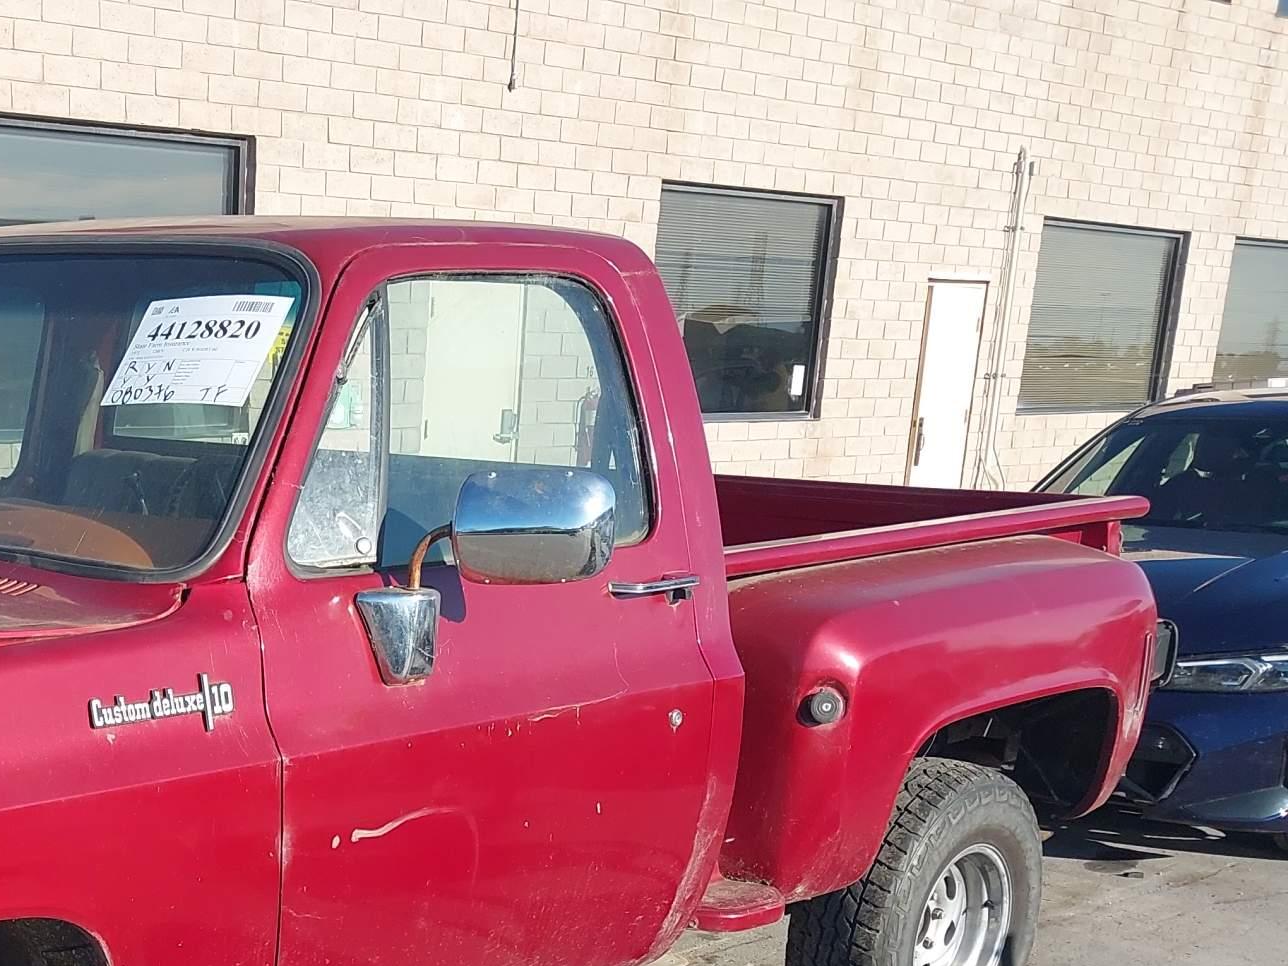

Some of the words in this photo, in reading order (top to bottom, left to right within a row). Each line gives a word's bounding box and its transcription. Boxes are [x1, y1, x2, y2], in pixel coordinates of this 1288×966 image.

[147, 319, 261, 341] 44128820
[163, 358, 176, 372] N
[91, 696, 151, 728] Custom
[152, 688, 205, 717] deluxe
[210, 682, 234, 715] 10
